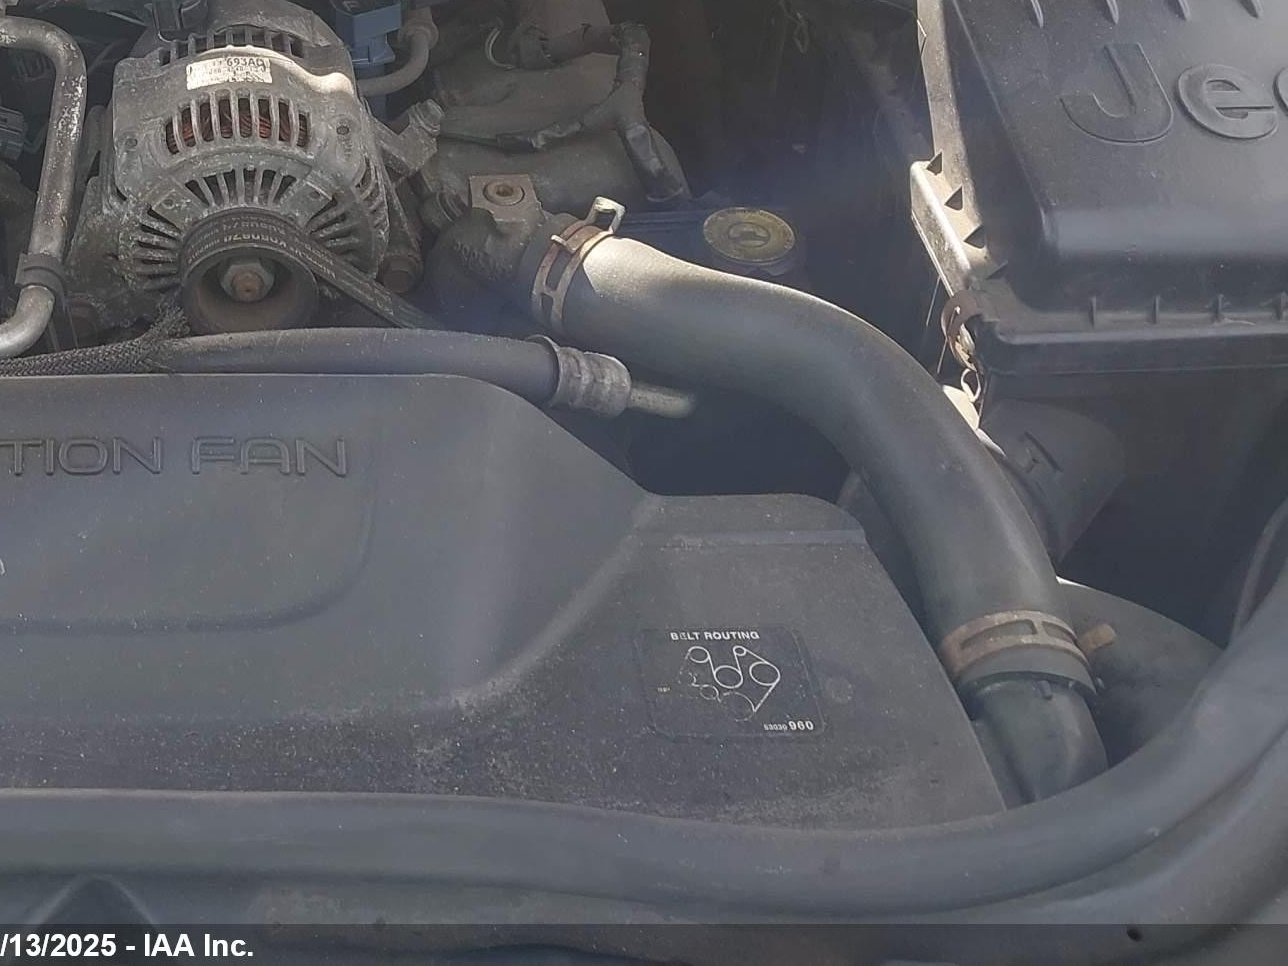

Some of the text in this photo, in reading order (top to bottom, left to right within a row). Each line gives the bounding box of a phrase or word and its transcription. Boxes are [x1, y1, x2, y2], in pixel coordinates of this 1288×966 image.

[1058, 41, 1288, 146] Je
[191, 436, 348, 479] FAN
[704, 630, 760, 640] ROUTING
